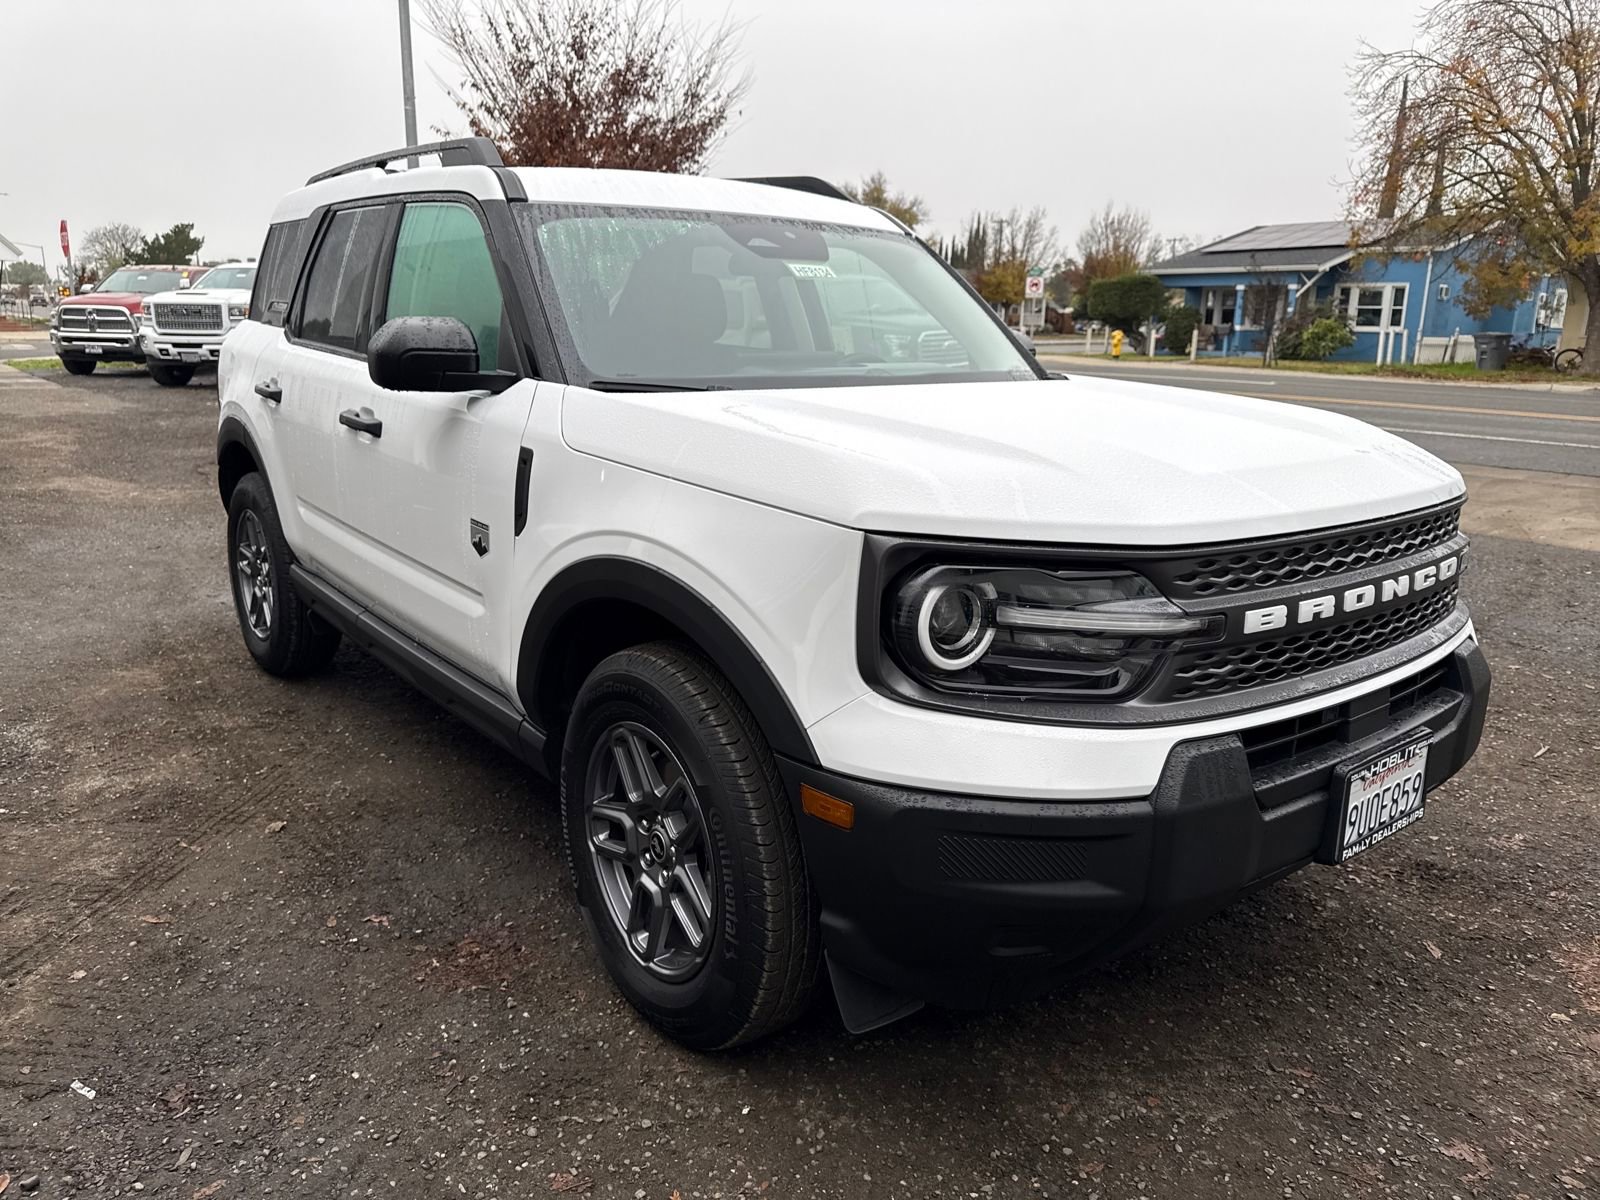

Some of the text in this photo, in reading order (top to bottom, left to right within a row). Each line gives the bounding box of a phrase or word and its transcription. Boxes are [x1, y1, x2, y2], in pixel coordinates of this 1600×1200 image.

[1243, 556, 1457, 634] BRONCO
[1371, 745, 1417, 775] HOBLIT
[1371, 808, 1424, 845] DEALERSHIPS
